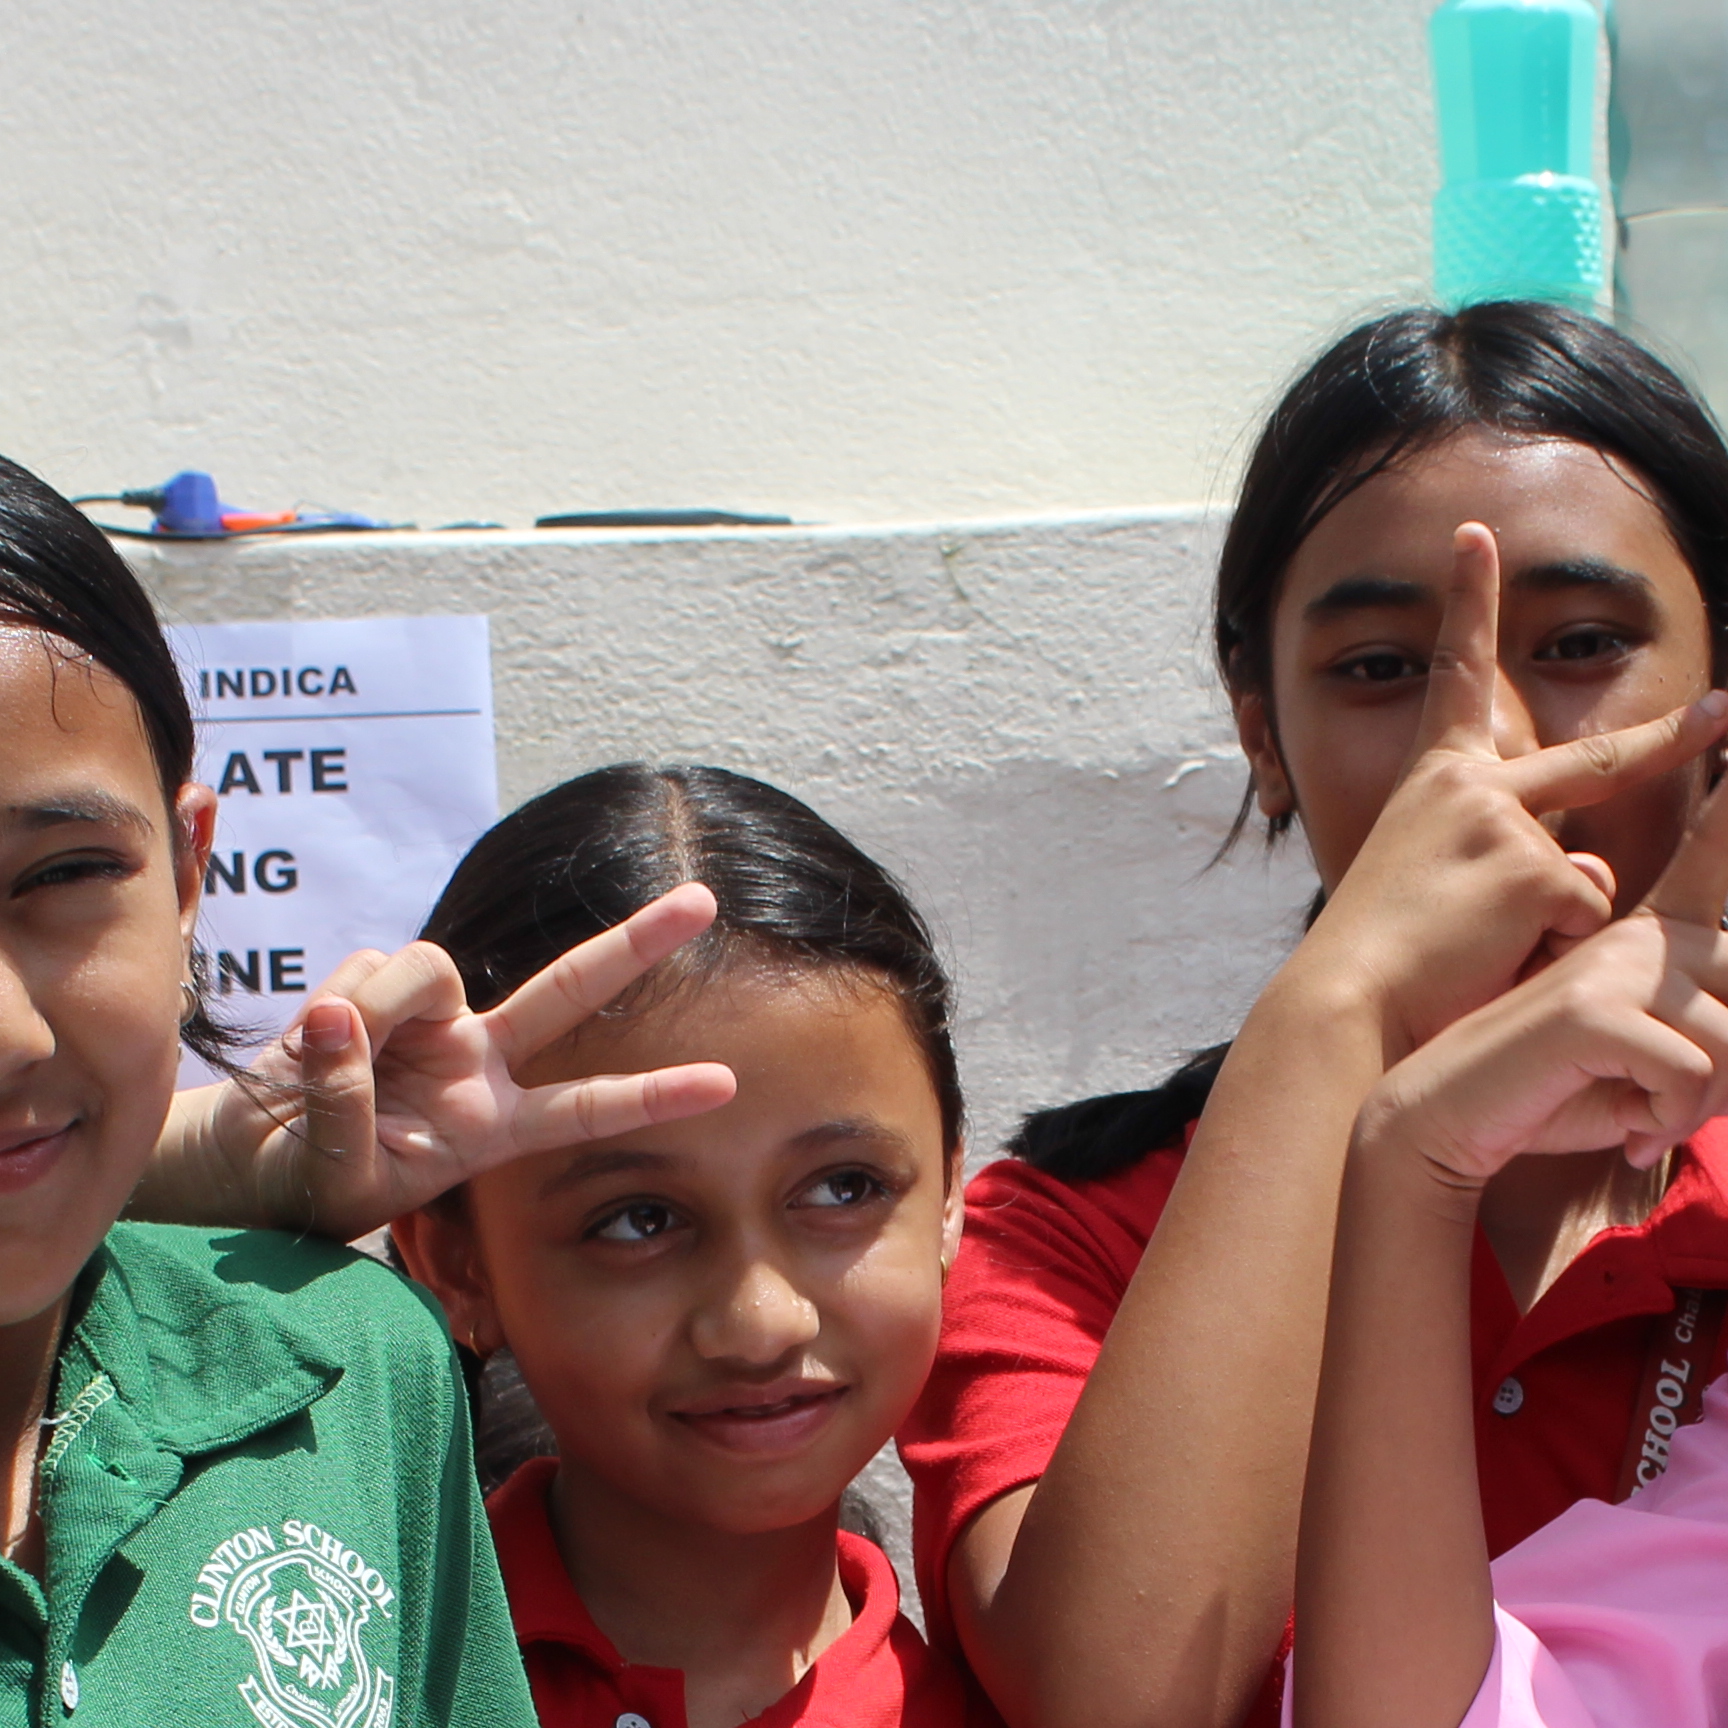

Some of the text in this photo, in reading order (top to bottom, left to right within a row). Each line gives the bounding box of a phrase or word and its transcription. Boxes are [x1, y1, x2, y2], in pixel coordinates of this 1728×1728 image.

[200, 665, 357, 699] INDICA
[209, 748, 348, 795] ATE
[1631, 1358, 1691, 1498] CHOOL
[190, 1520, 396, 1627] CLINTON SCHOOL
[235, 1566, 355, 1615] CLINTON SCHOOL
